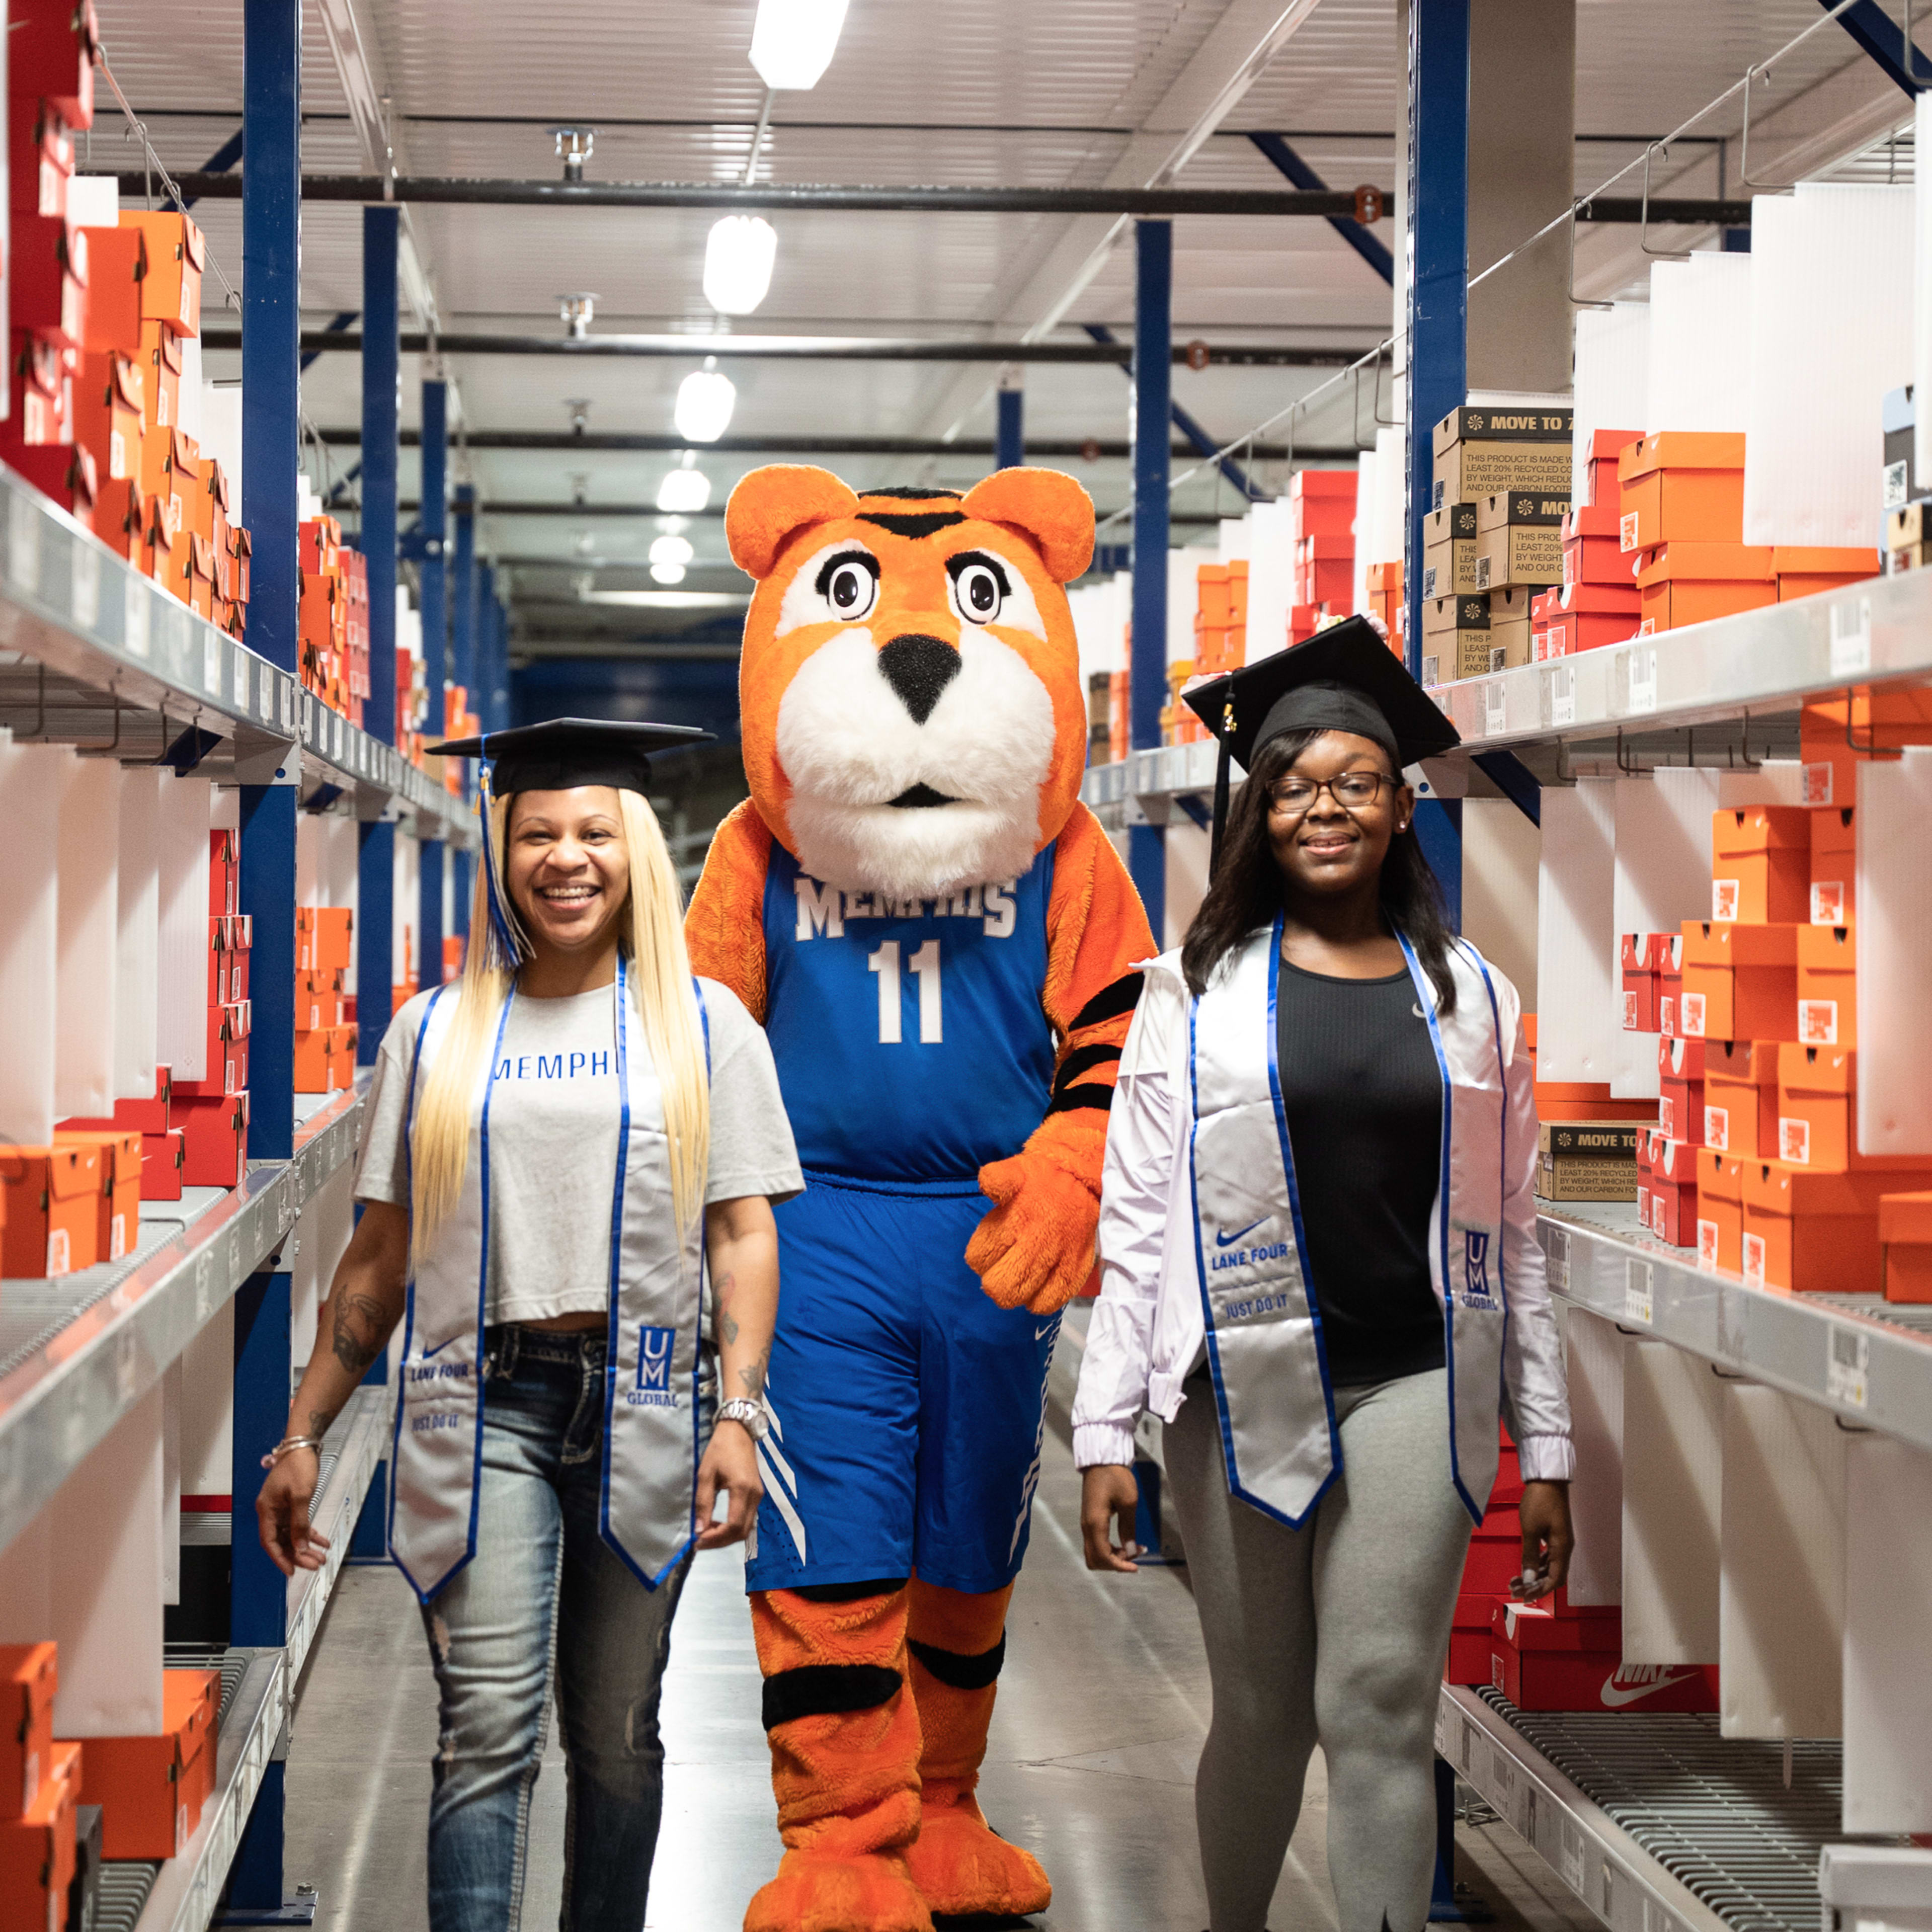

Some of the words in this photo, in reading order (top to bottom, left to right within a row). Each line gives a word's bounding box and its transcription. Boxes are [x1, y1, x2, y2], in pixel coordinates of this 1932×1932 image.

[1490, 416, 1537, 430] MOVE
[1541, 417, 1562, 431] TO
[1466, 454, 1485, 462] THIS
[1487, 455, 1527, 463] PRODUCT
[1530, 455, 1538, 463] IS
[1480, 474, 1513, 482] WEIGHT,
[1541, 501, 1572, 515] MO
[1516, 533, 1536, 541] THIS
[1516, 543, 1543, 551] LEAST
[1460, 555, 1477, 563] LEA
[1465, 645, 1490, 653] LEAST
[868, 939, 943, 1044] 11
[1578, 1134, 1618, 1147] MOVE
[1212, 1251, 1246, 1270] LANE
[1250, 1243, 1288, 1262] FOUR
[1227, 1301, 1252, 1319] JUST
[1256, 1297, 1273, 1313] DO
[1276, 1294, 1287, 1308] IT
[1462, 1295, 1498, 1311] GLOBAL
[439, 1363, 468, 1378] FOUR
[627, 1392, 678, 1407] GLOBAL
